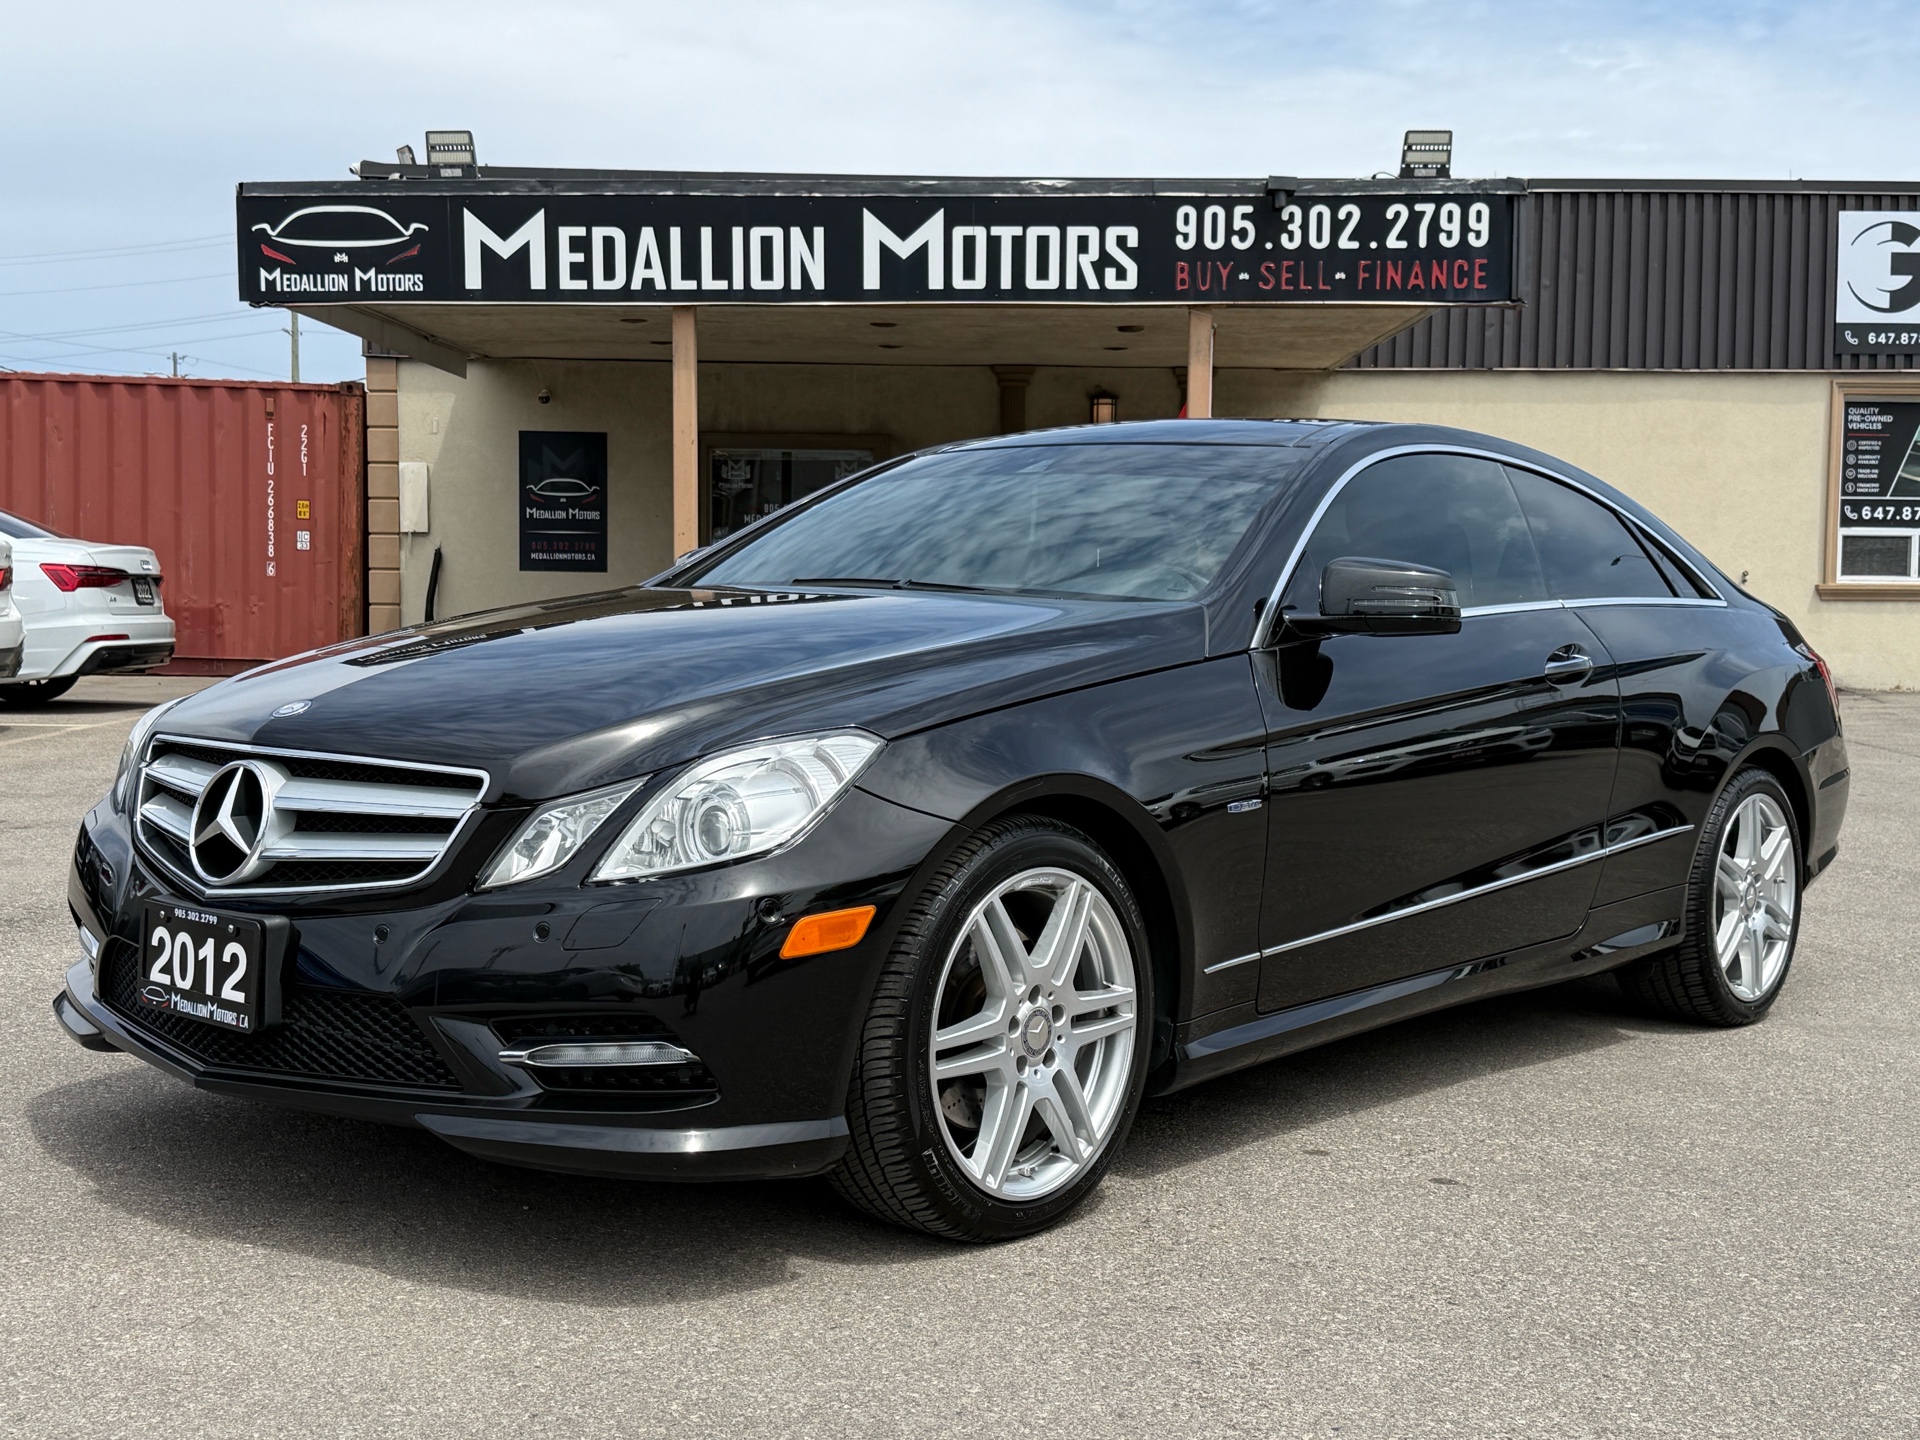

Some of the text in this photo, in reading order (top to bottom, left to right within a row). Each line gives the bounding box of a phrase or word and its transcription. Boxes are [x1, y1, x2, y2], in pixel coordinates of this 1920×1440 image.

[1175, 202, 1490, 250] 905.302.2799
[463, 207, 1139, 291] MEDALLION MOTORS
[260, 267, 424, 292] MEDALLION MOTORS
[1175, 258, 1488, 291] BUY SELL FINANCE
[1848, 407, 1879, 415] QUALITY
[1848, 415, 1894, 423] PRE-OWNED
[1847, 422, 1882, 430] VEHICLES
[267, 423, 275, 476] FCIU
[526, 506, 600, 520] MEDALLION MOTORS
[530, 552, 596, 561] MEDALLIONMOTORS.CA
[174, 907, 218, 925] 905 302 2799
[149, 925, 248, 1004] 2012
